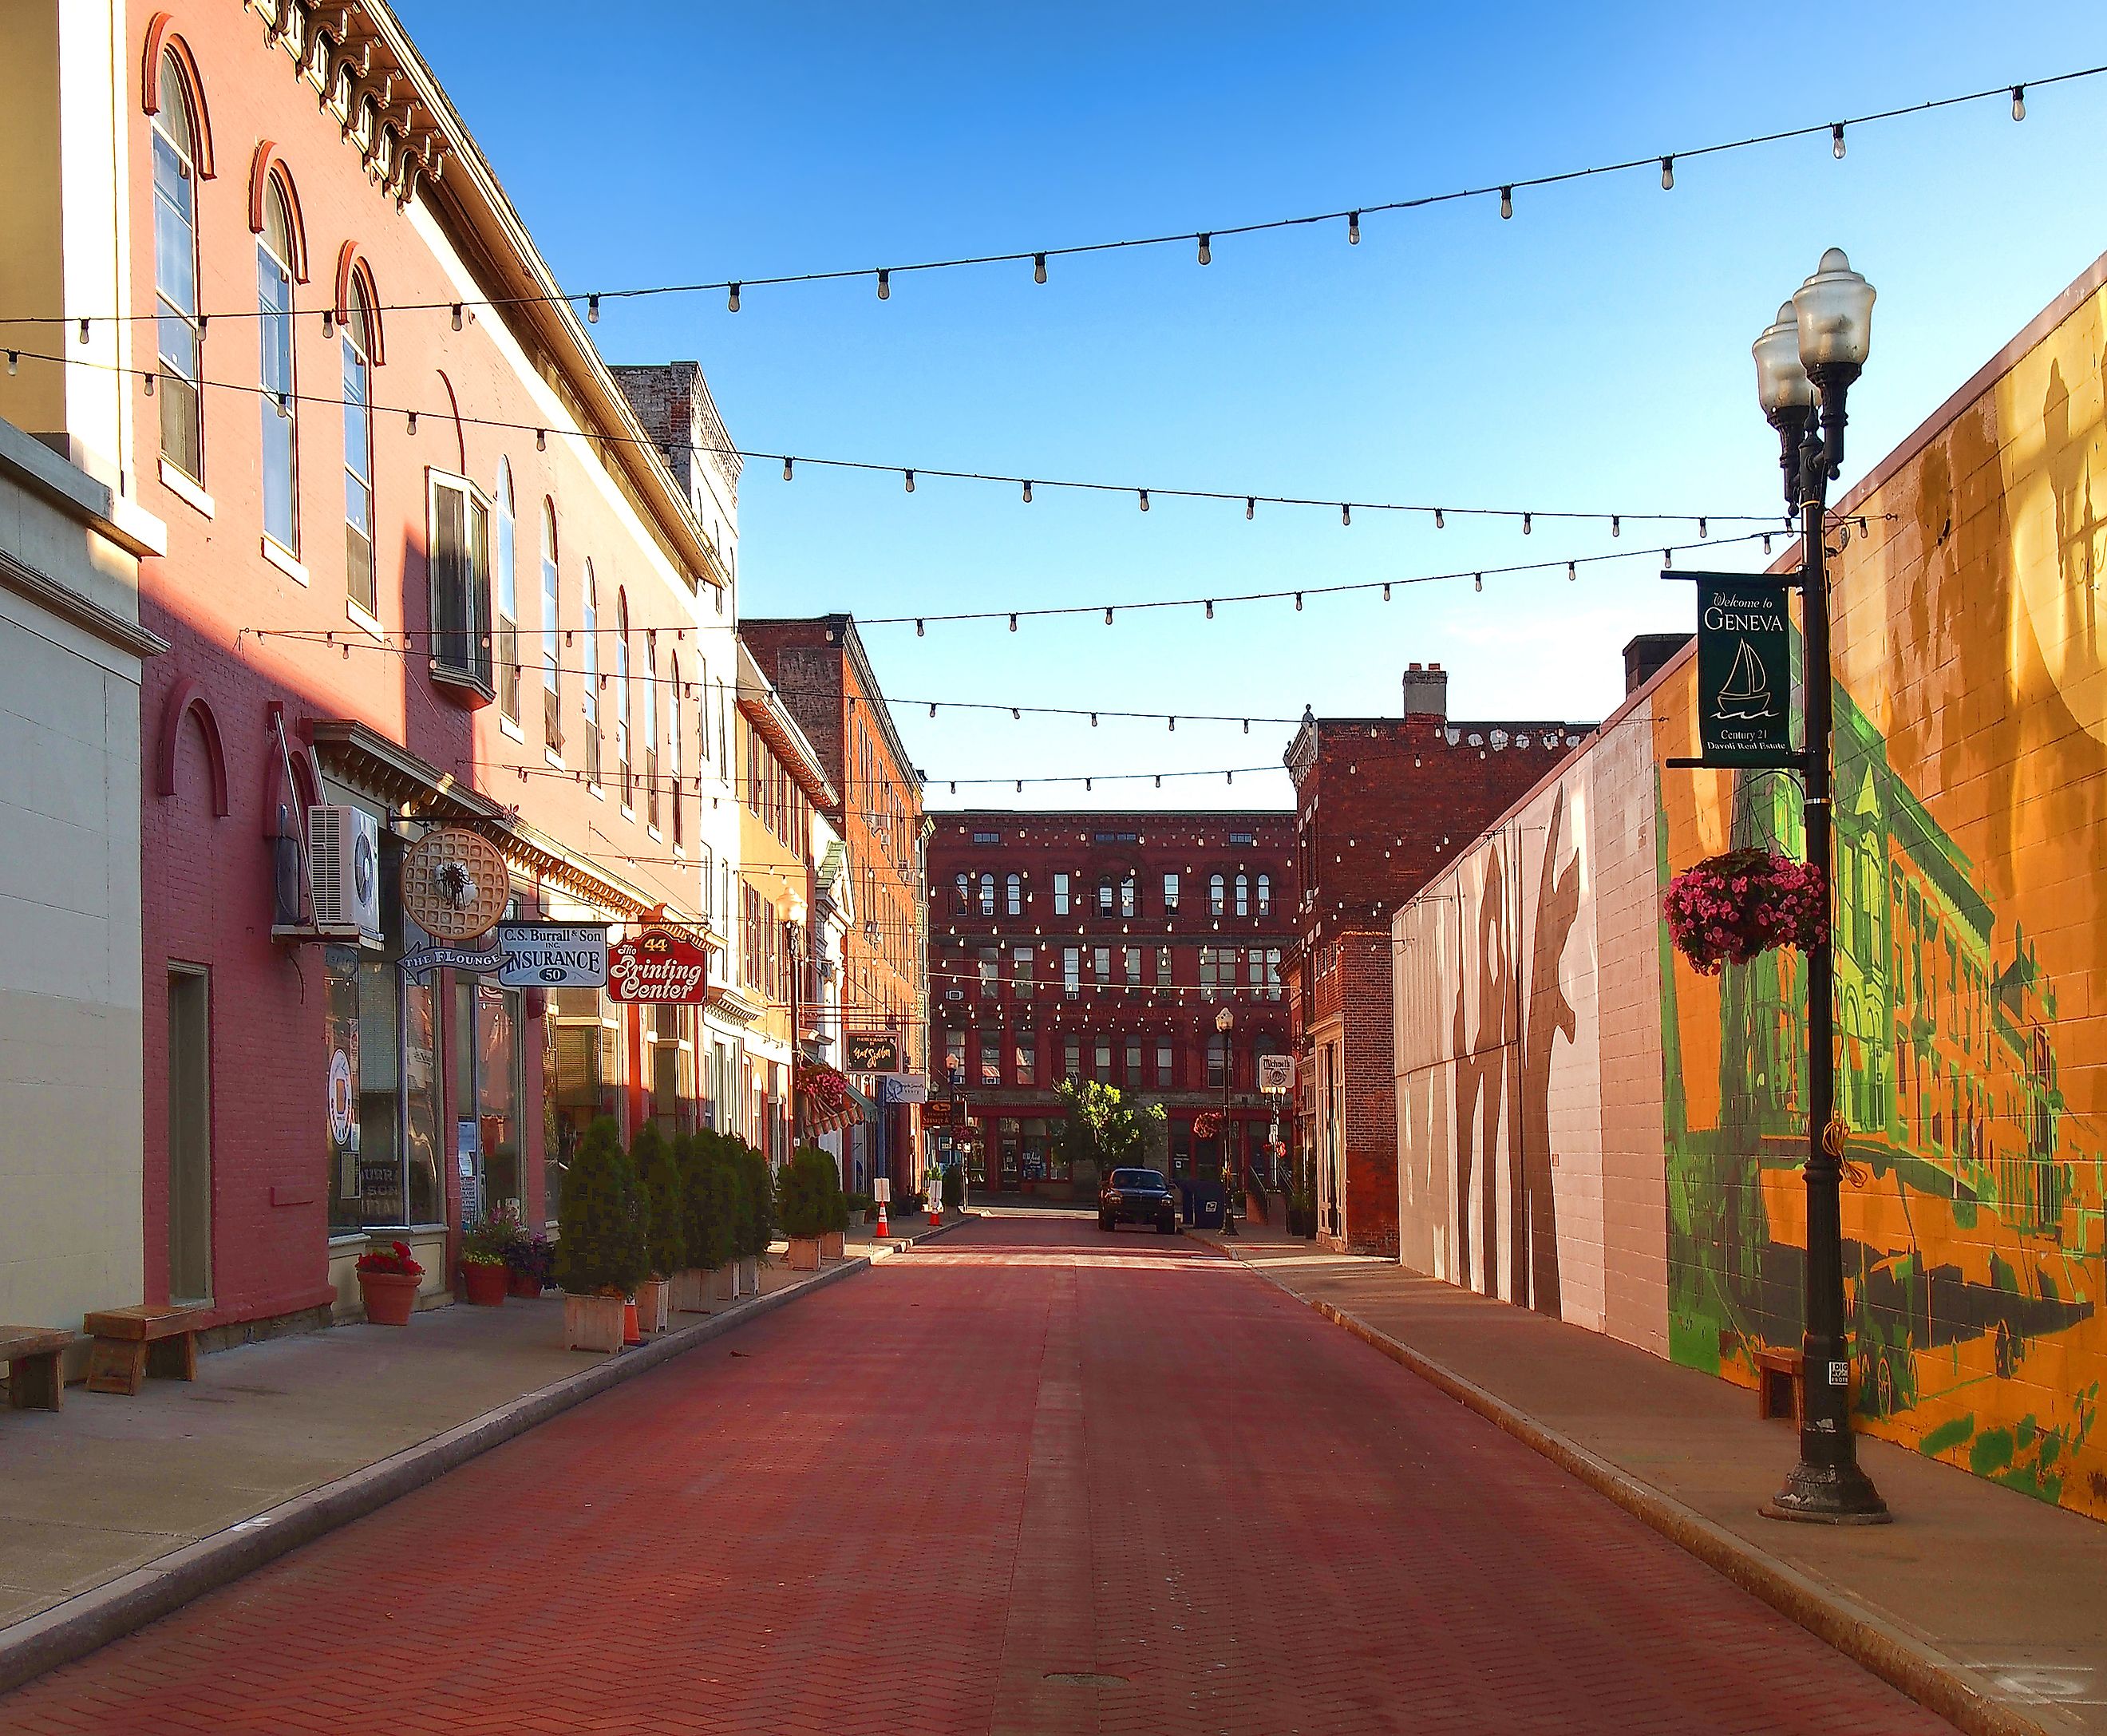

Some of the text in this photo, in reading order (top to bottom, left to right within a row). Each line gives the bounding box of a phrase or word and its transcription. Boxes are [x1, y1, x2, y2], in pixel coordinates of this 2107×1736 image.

[1714, 592, 1773, 608] Welcome to
[1704, 607, 1784, 631] GENEVA
[1721, 730, 1767, 741] Century 21
[504, 929, 528, 941] C.S.
[530, 929, 570, 941] Burrall
[579, 930, 601, 942] Son
[618, 944, 637, 955] The
[644, 939, 668, 951] 44
[405, 955, 431, 967] THE
[505, 951, 600, 974] INSURANCE
[545, 970, 560, 980] 50
[611, 955, 702, 985] Printing
[621, 977, 693, 998] Center
[1263, 1058, 1290, 1068] Michael's
